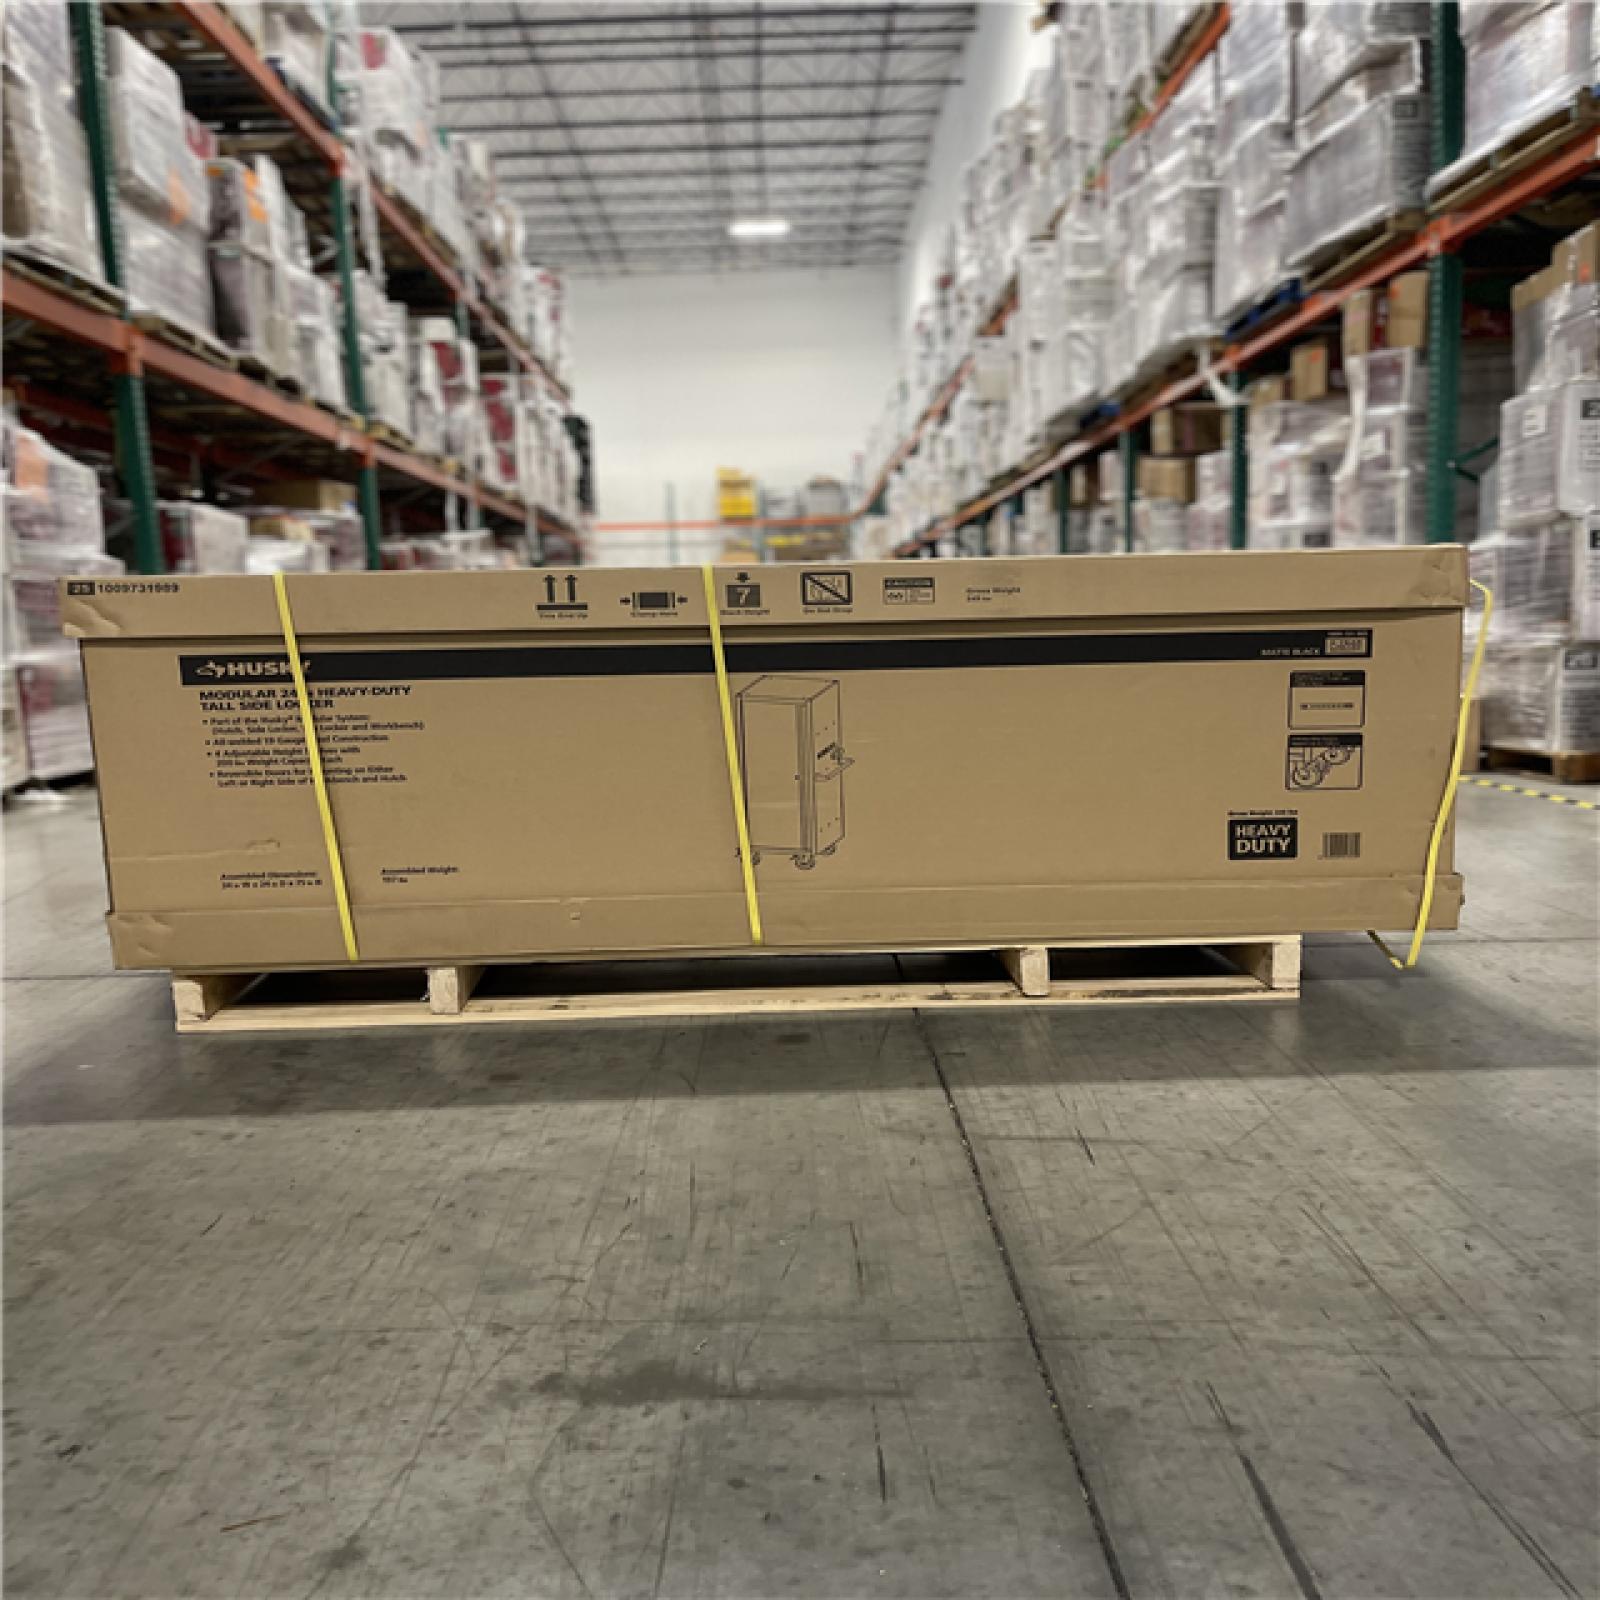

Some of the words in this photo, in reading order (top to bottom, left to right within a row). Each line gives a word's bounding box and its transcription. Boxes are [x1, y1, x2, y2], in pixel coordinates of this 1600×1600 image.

[736, 587, 751, 605] 7
[317, 686, 412, 697] HEAVY-DUTY
[200, 702, 236, 711] TALL
[240, 701, 273, 711] SIDE
[1235, 823, 1291, 836] HEAVY
[1235, 838, 1291, 854] DUTY
